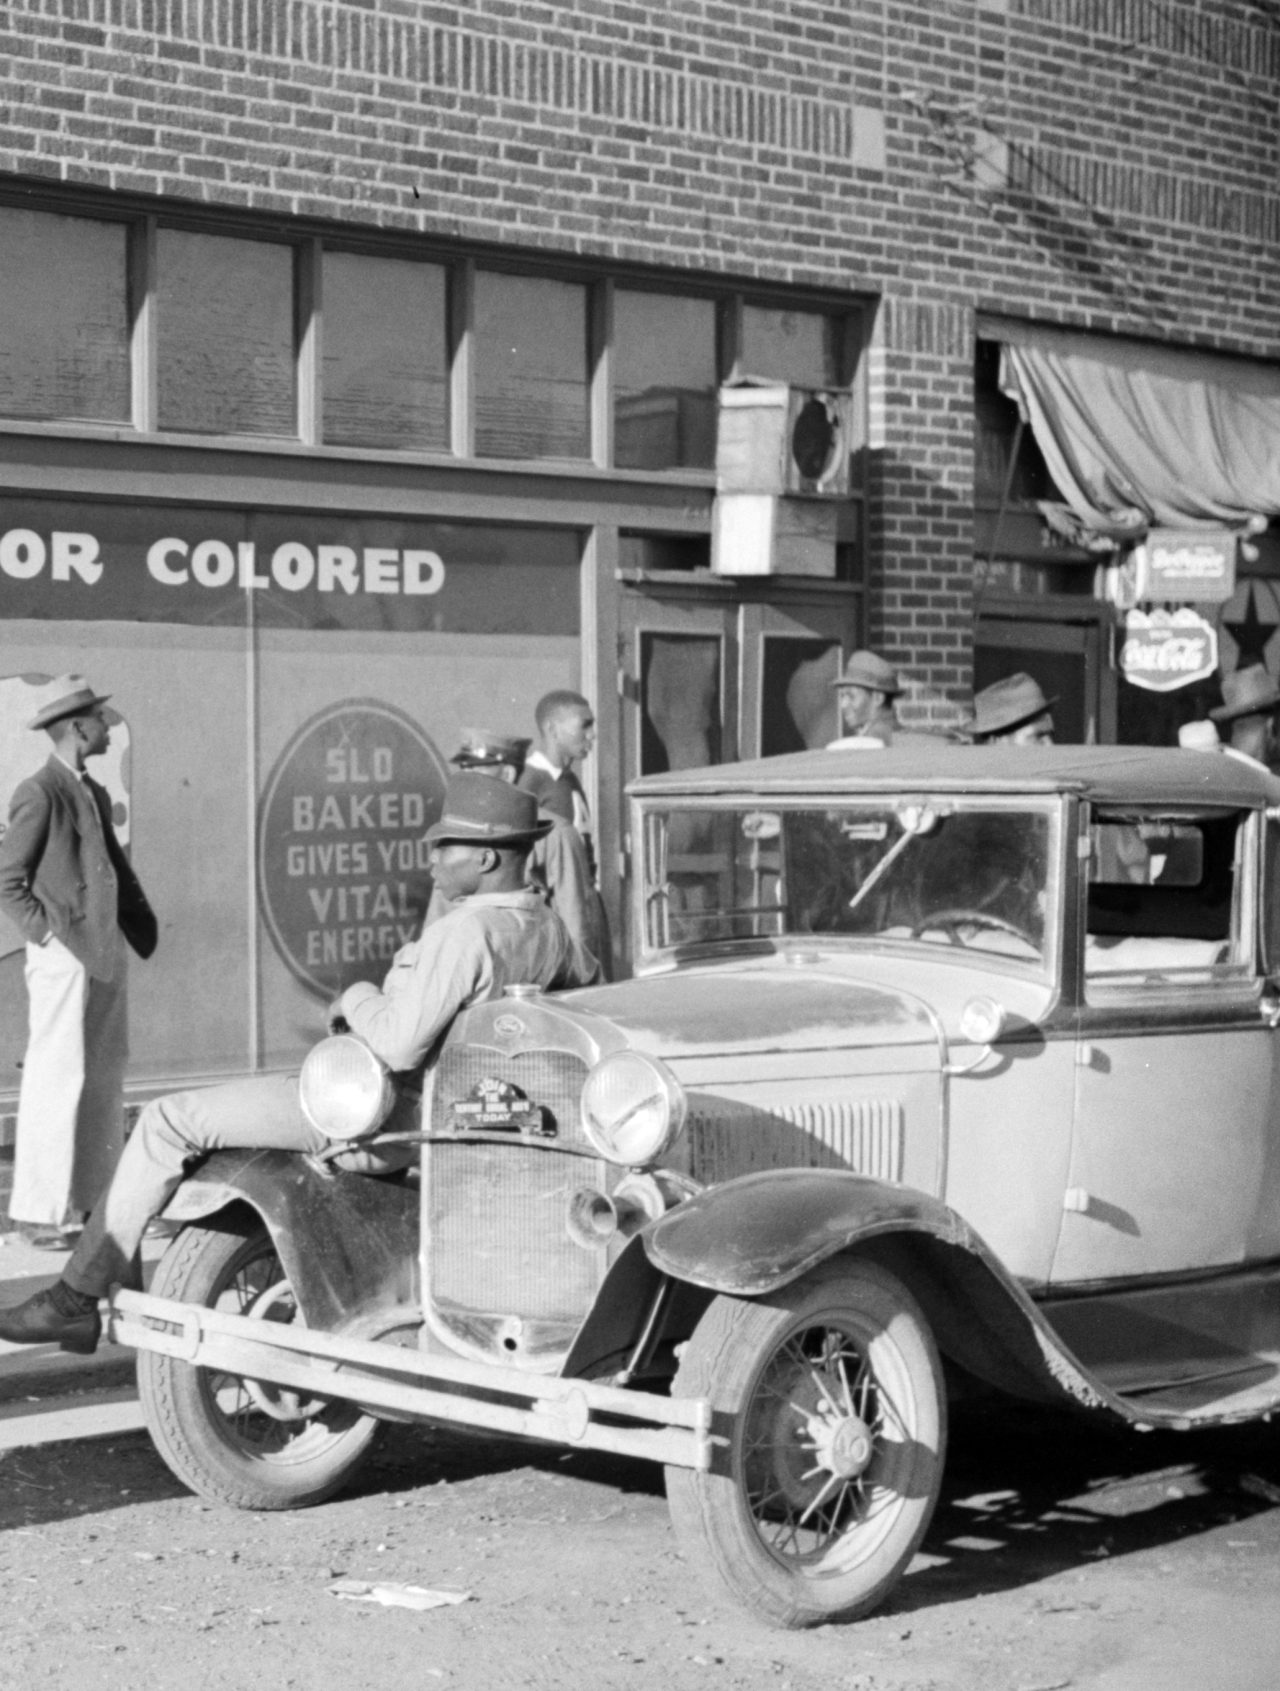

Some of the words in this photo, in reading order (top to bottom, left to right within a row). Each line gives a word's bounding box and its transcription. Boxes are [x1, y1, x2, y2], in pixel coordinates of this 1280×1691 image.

[147, 538, 445, 595] COLORED
[326, 747, 393, 783] SLO
[293, 793, 425, 832] BAKED
[287, 843, 368, 876] GIVES
[377, 839, 433, 871] YOU
[308, 882, 418, 923] VITAL
[475, 1114, 511, 1122] TODAY
